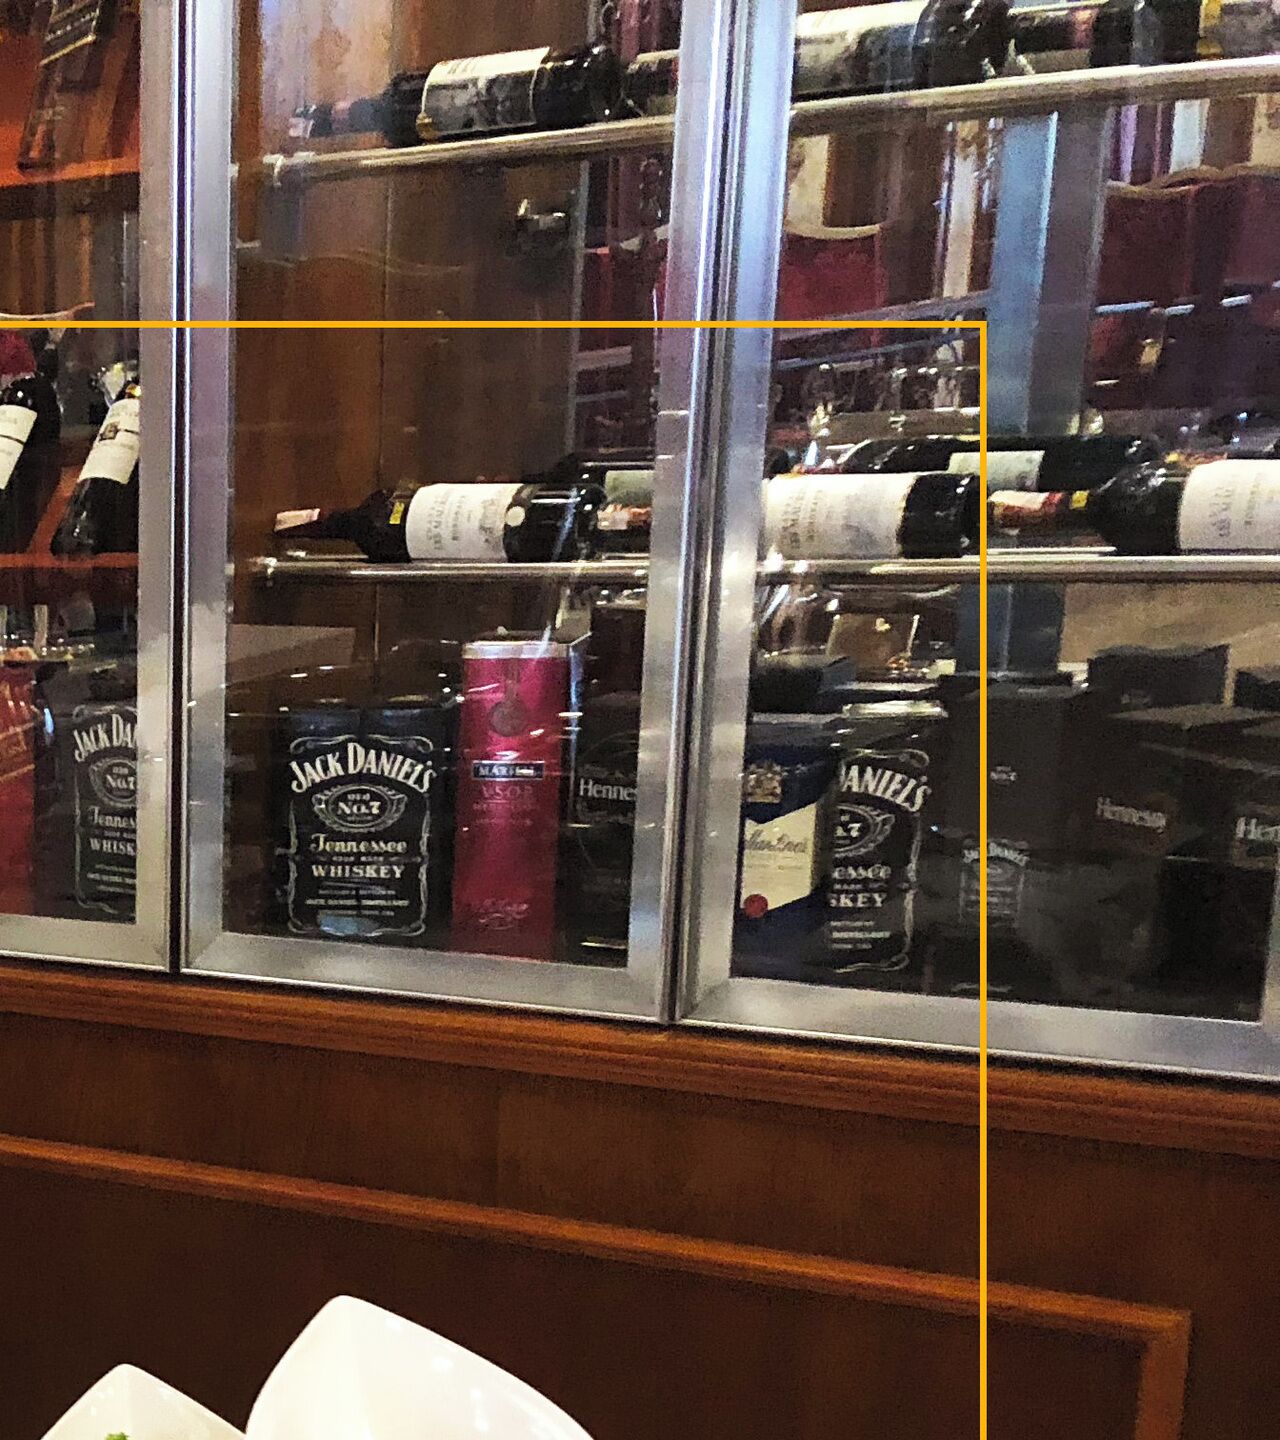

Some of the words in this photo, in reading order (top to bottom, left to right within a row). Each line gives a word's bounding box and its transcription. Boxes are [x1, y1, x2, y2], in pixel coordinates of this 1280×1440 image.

[73, 723, 111, 763] JACK
[288, 751, 345, 793] JACK
[346, 741, 438, 794] DANIEL'S
[309, 832, 408, 854] Tennessee
[311, 864, 406, 879] WHISKEY
